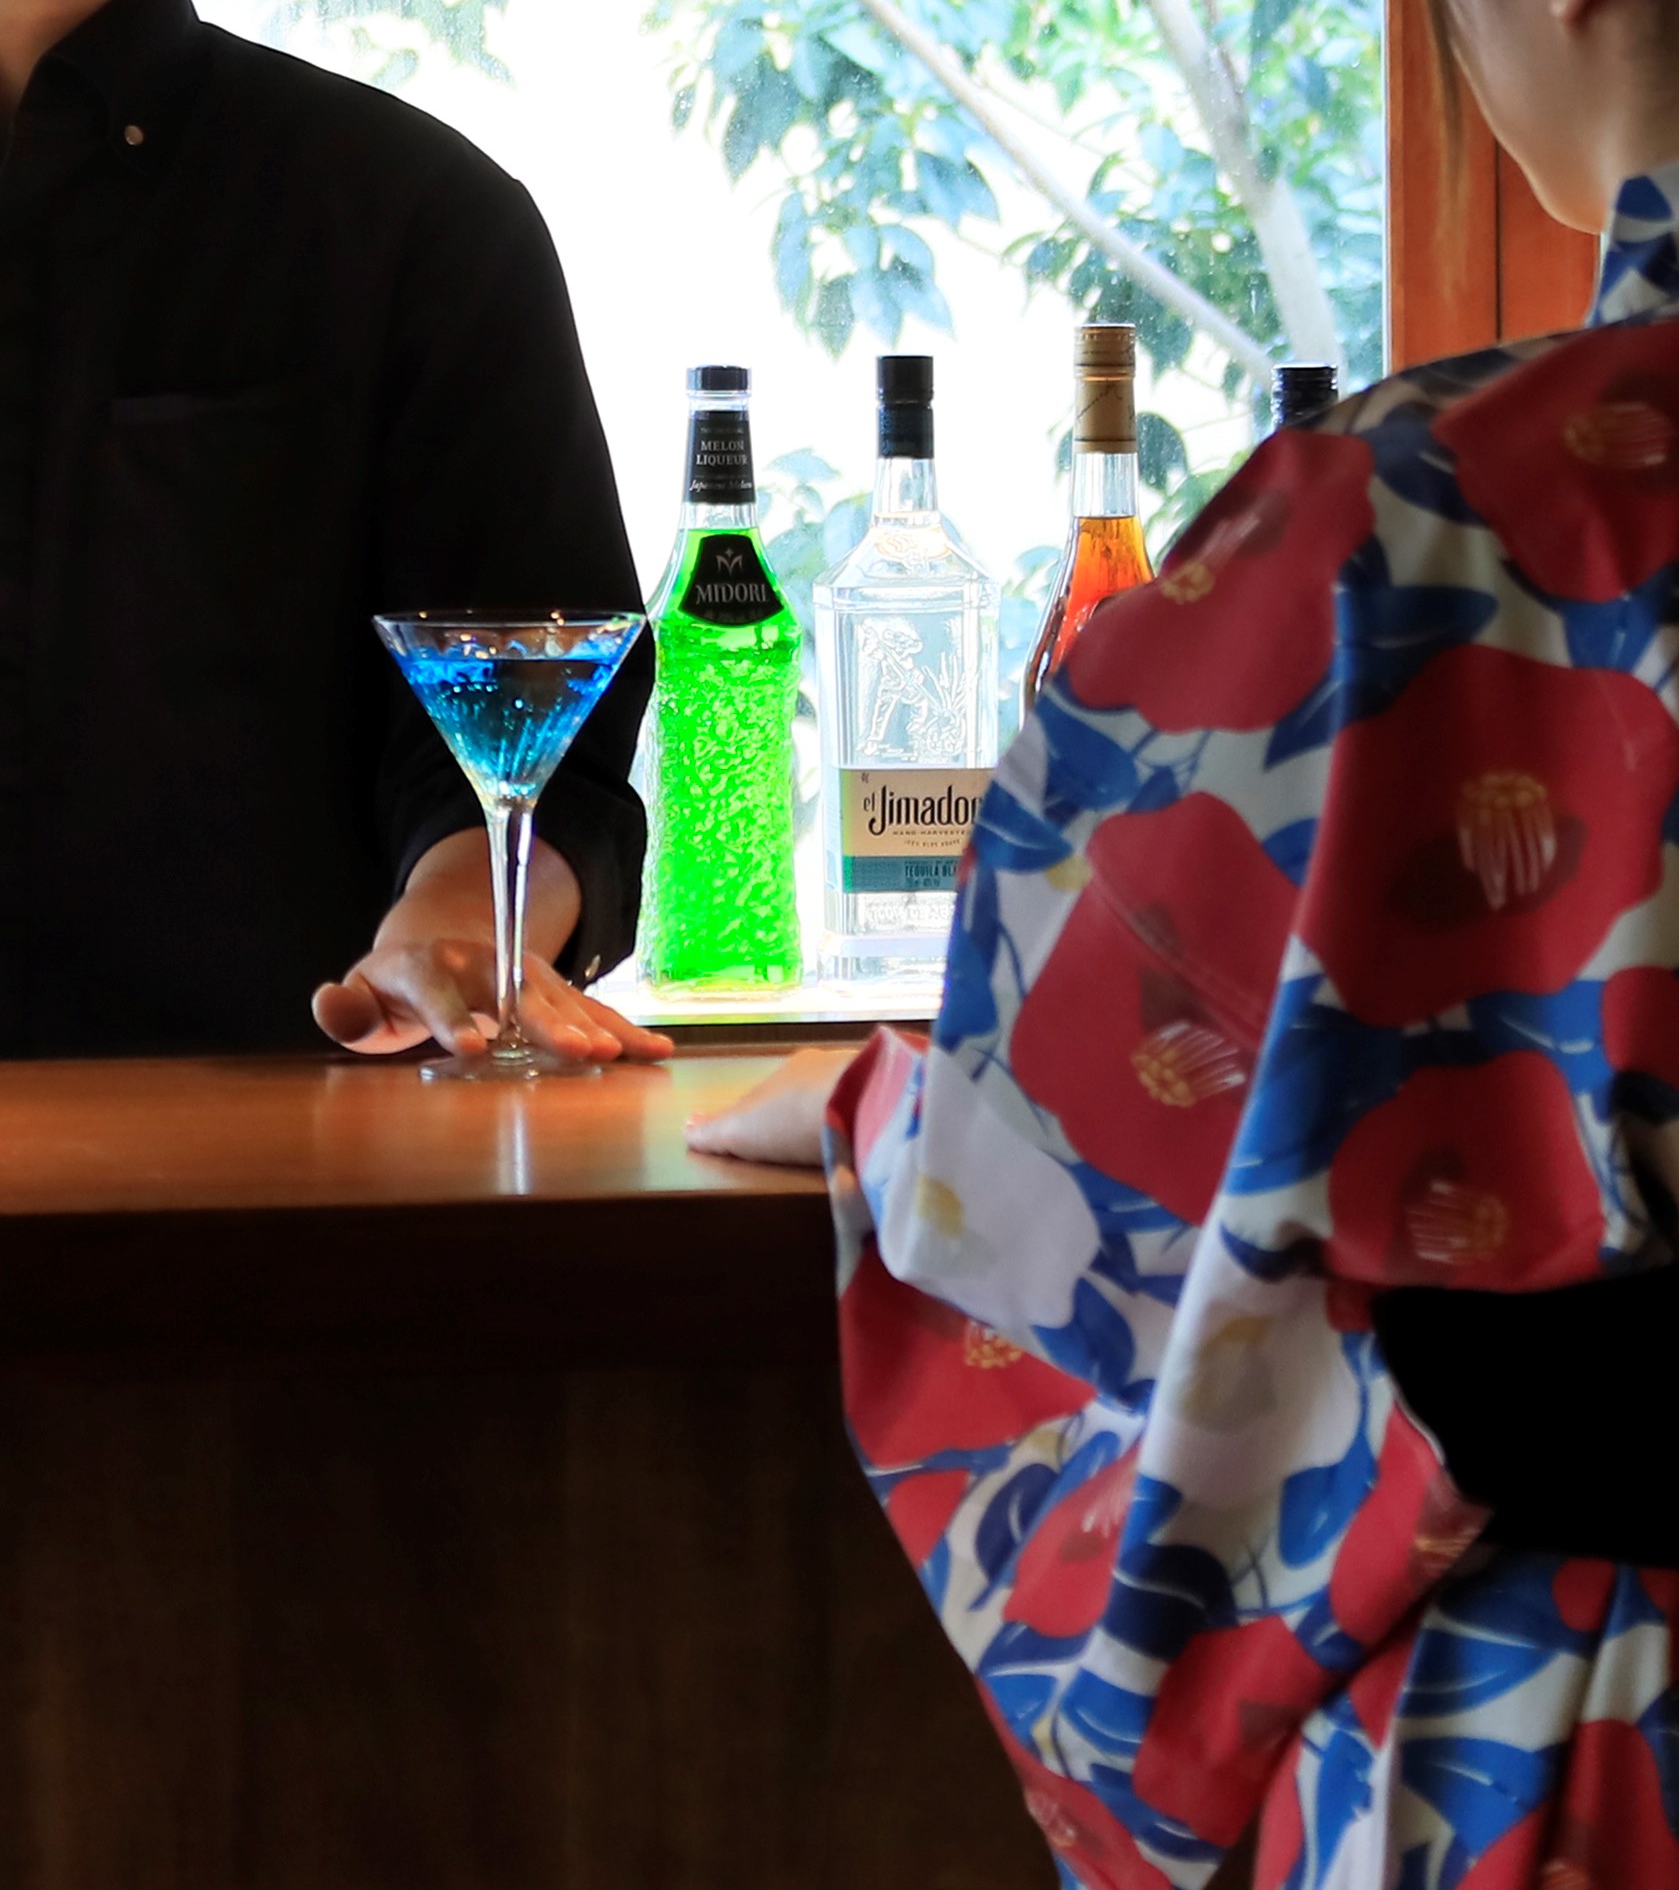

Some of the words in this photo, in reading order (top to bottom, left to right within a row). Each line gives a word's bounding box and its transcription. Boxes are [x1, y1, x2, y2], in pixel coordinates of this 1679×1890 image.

[701, 441, 745, 451] MELON
[696, 454, 748, 467] LIQUEUR
[696, 583, 769, 605] MIDORI
[863, 792, 876, 812] el
